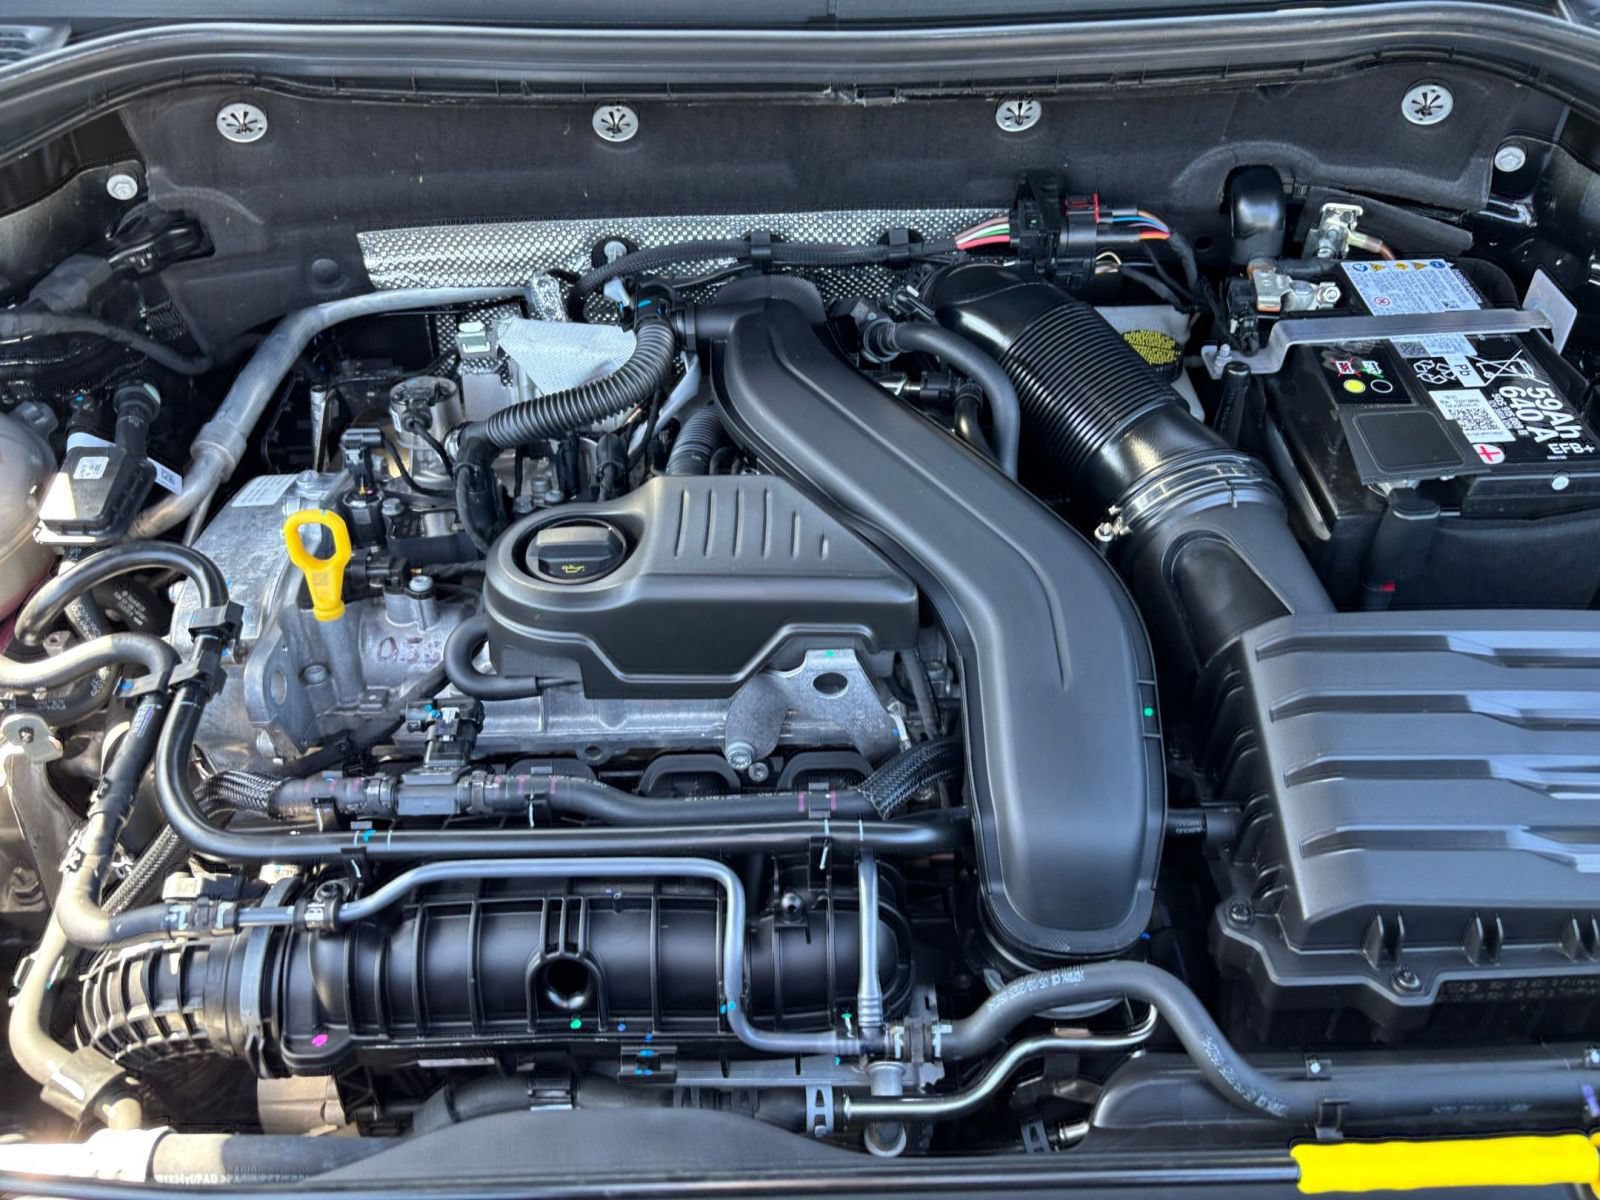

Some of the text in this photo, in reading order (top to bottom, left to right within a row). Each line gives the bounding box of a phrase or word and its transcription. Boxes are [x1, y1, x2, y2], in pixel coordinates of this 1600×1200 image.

[1454, 363, 1471, 376] Pb
[1499, 385, 1545, 422] 640
[1526, 425, 1560, 443] A
[1526, 386, 1582, 439] 59Ah
[1547, 442, 1595, 454] EFB+
